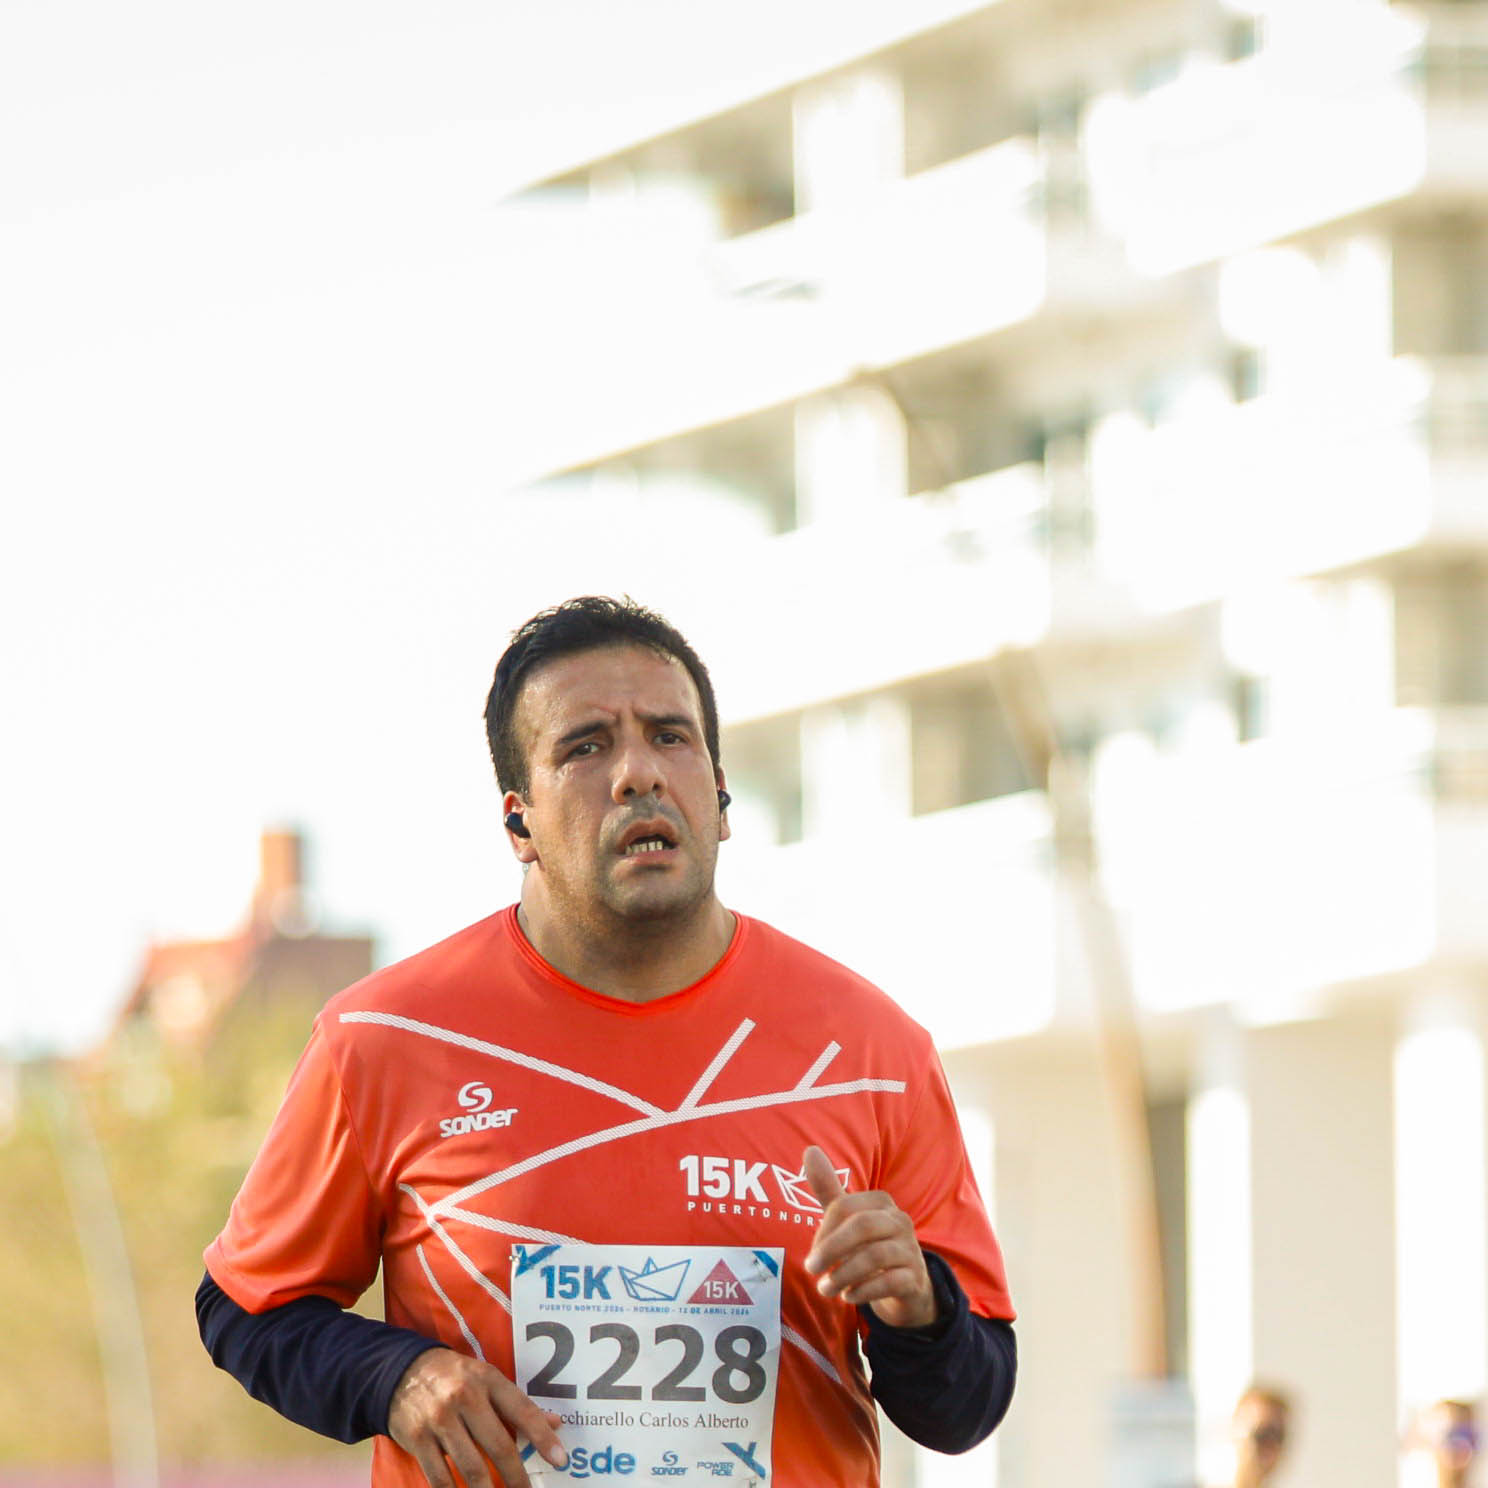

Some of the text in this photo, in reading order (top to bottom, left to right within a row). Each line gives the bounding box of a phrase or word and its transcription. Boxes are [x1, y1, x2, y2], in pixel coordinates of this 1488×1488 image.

[679, 1154, 770, 1203] 15K
[687, 1201, 824, 1227] PUERTO NOR
[540, 1265, 612, 1300] 15K
[703, 1280, 739, 1299] 15K
[525, 1321, 767, 1404] 2228
[639, 1411, 689, 1428] Carlos
[694, 1412, 749, 1429] Alberto
